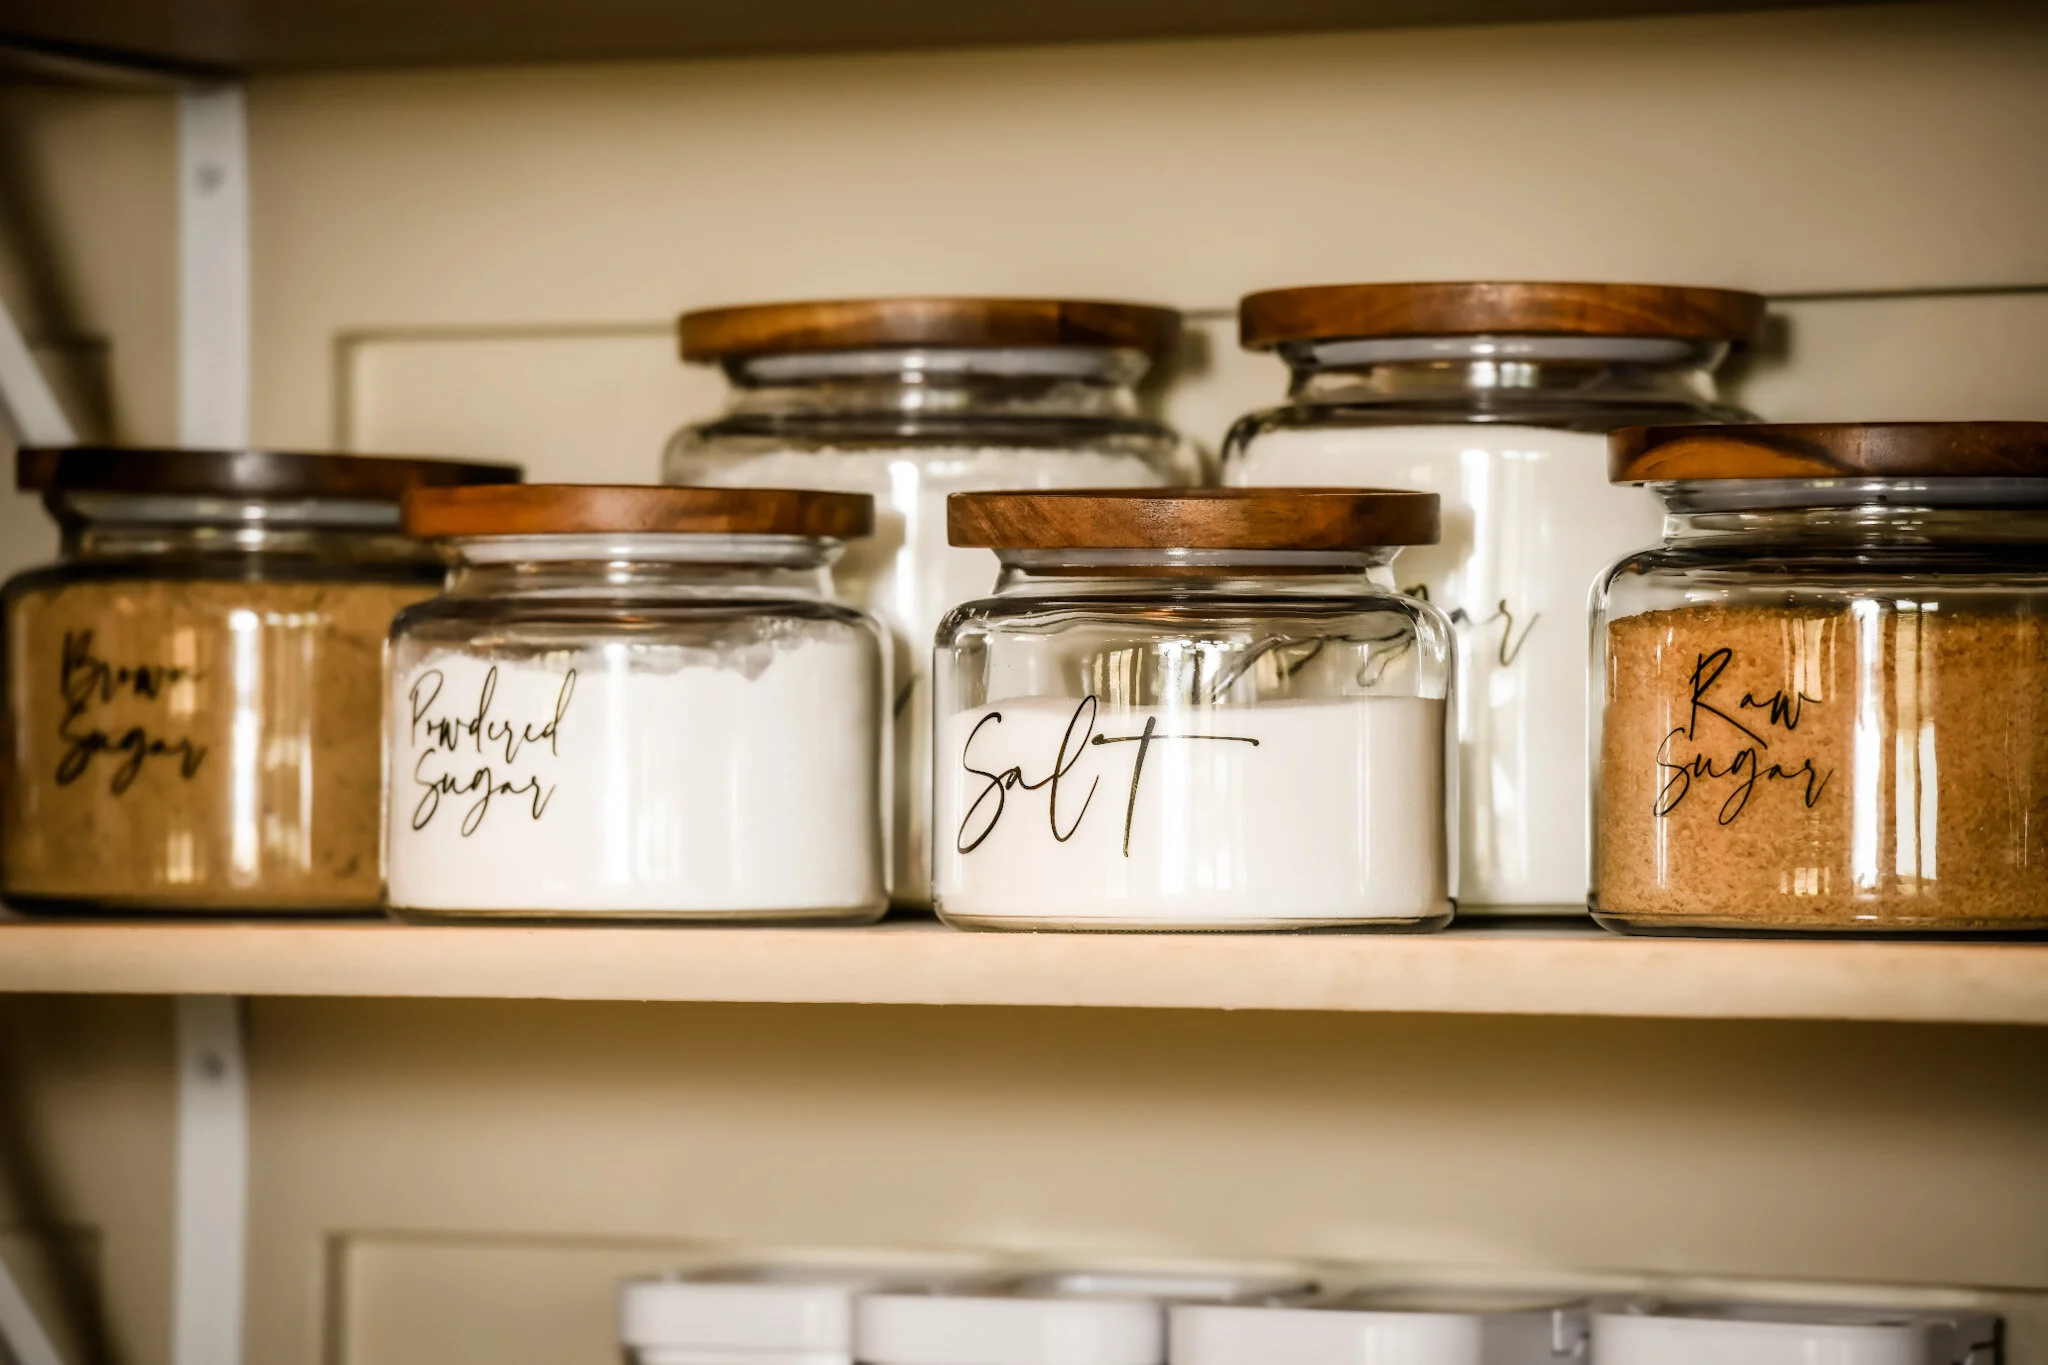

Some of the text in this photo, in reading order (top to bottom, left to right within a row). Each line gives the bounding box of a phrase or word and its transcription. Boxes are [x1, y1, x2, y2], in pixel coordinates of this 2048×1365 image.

[409, 665, 577, 763] Powdered
[1689, 647, 1822, 748] Raw
[55, 699, 206, 796] Sugar
[412, 748, 557, 837] Sugar
[957, 695, 1260, 858] Salt
[1653, 727, 1834, 826] Sugar
